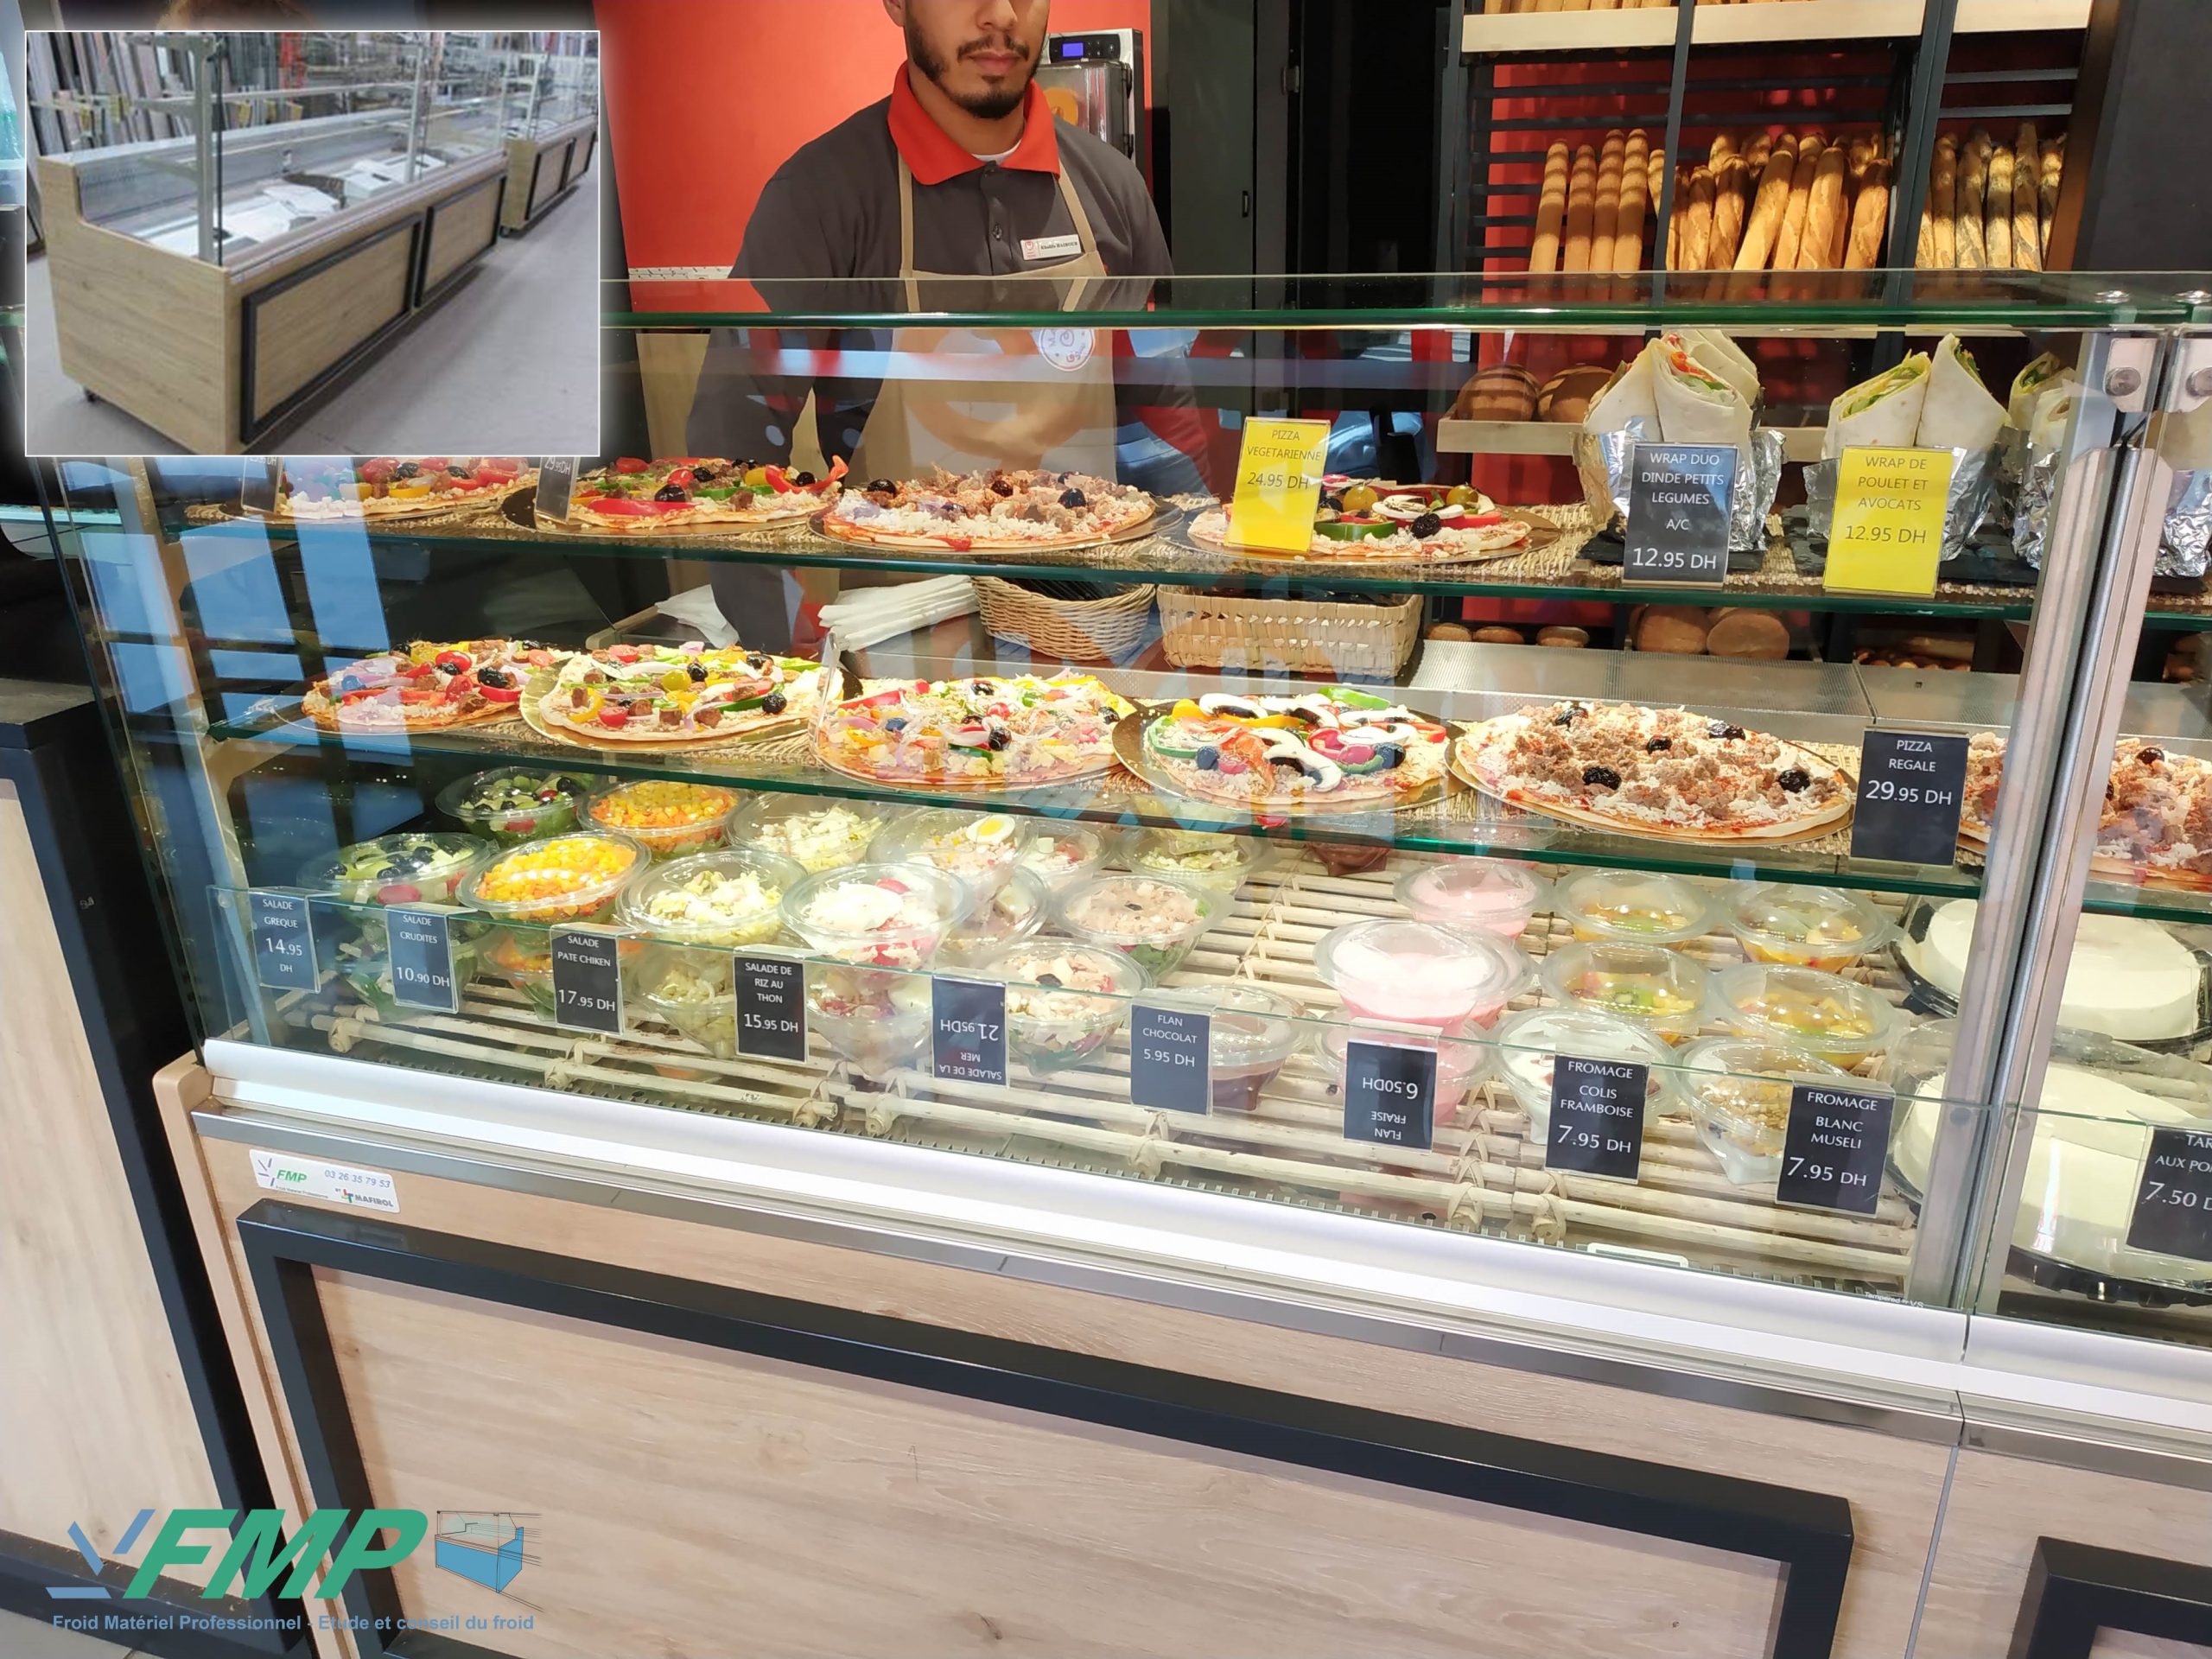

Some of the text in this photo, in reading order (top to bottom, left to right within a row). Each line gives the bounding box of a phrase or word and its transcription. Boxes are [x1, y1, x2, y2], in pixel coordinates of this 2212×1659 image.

[1272, 429, 1300, 441] PIZZA
[1247, 446, 1321, 461] VEGETARIENNE
[1650, 453, 1720, 465] WRAP DUO
[1866, 456, 1927, 470] WRAP DE
[1247, 472, 1309, 489] 24.95 DH
[1642, 472, 1724, 485] DINDE PETITS
[1858, 476, 1929, 491] POULET ET
[1651, 492, 1710, 505] LEGUMES
[1858, 497, 1922, 511] AVOCATS
[1666, 518, 1689, 531] A/C
[1845, 525, 1927, 543] 12.95 DH
[1632, 547, 1717, 569] 12.95 DH
[1896, 740, 1933, 753] PIZZA
[1888, 758, 1936, 772] REGALE
[1866, 779, 1952, 805] 29.95 DH
[263, 899, 294, 910] SALADE
[264, 916, 298, 928] GREQUE
[403, 914, 432, 926] SALADE
[400, 931, 438, 944] CRUDITES
[568, 935, 600, 948] SALADE
[265, 937, 302, 957] 14.95
[557, 950, 611, 967] PATE CHIKEN
[279, 963, 293, 973] DH
[745, 962, 792, 976] SALADE DE
[397, 967, 450, 988] 10.90 DH
[754, 978, 784, 989] RIZ AU
[558, 989, 615, 1012] 17.95 DH
[757, 993, 783, 1003] THON
[744, 1014, 799, 1033] 15.95 DH
[1157, 1014, 1183, 1027] FLAN
[1142, 1027, 1198, 1044] CHOCOLAT
[960, 1052, 981, 1063] MER
[1143, 1048, 1195, 1067] 5.95 DH
[939, 1064, 1002, 1080] SALADE DE LA
[1567, 1060, 1634, 1079] FROMAGE
[1363, 1077, 1418, 1100] 6.50DH
[1579, 1084, 1618, 1099] COLIS
[1560, 1099, 1634, 1118] FRAMBOISE
[1807, 1091, 1878, 1111] FROMAGE
[1370, 1110, 1406, 1124] FRAISE
[1815, 1116, 1864, 1132] BLANC
[1374, 1128, 1402, 1141] FLAN
[1557, 1124, 1631, 1154] 7.95 DH
[1810, 1133, 1862, 1149] MUSELI
[1787, 1156, 1867, 1187] 7.95 DH
[2155, 1155, 2212, 1173] AUX PO
[276, 1169, 308, 1182] FMP
[325, 1169, 391, 1188] 03 26 35 79 53
[355, 1194, 394, 1207] MAFIROL
[2145, 1180, 2197, 1207] 7.50
